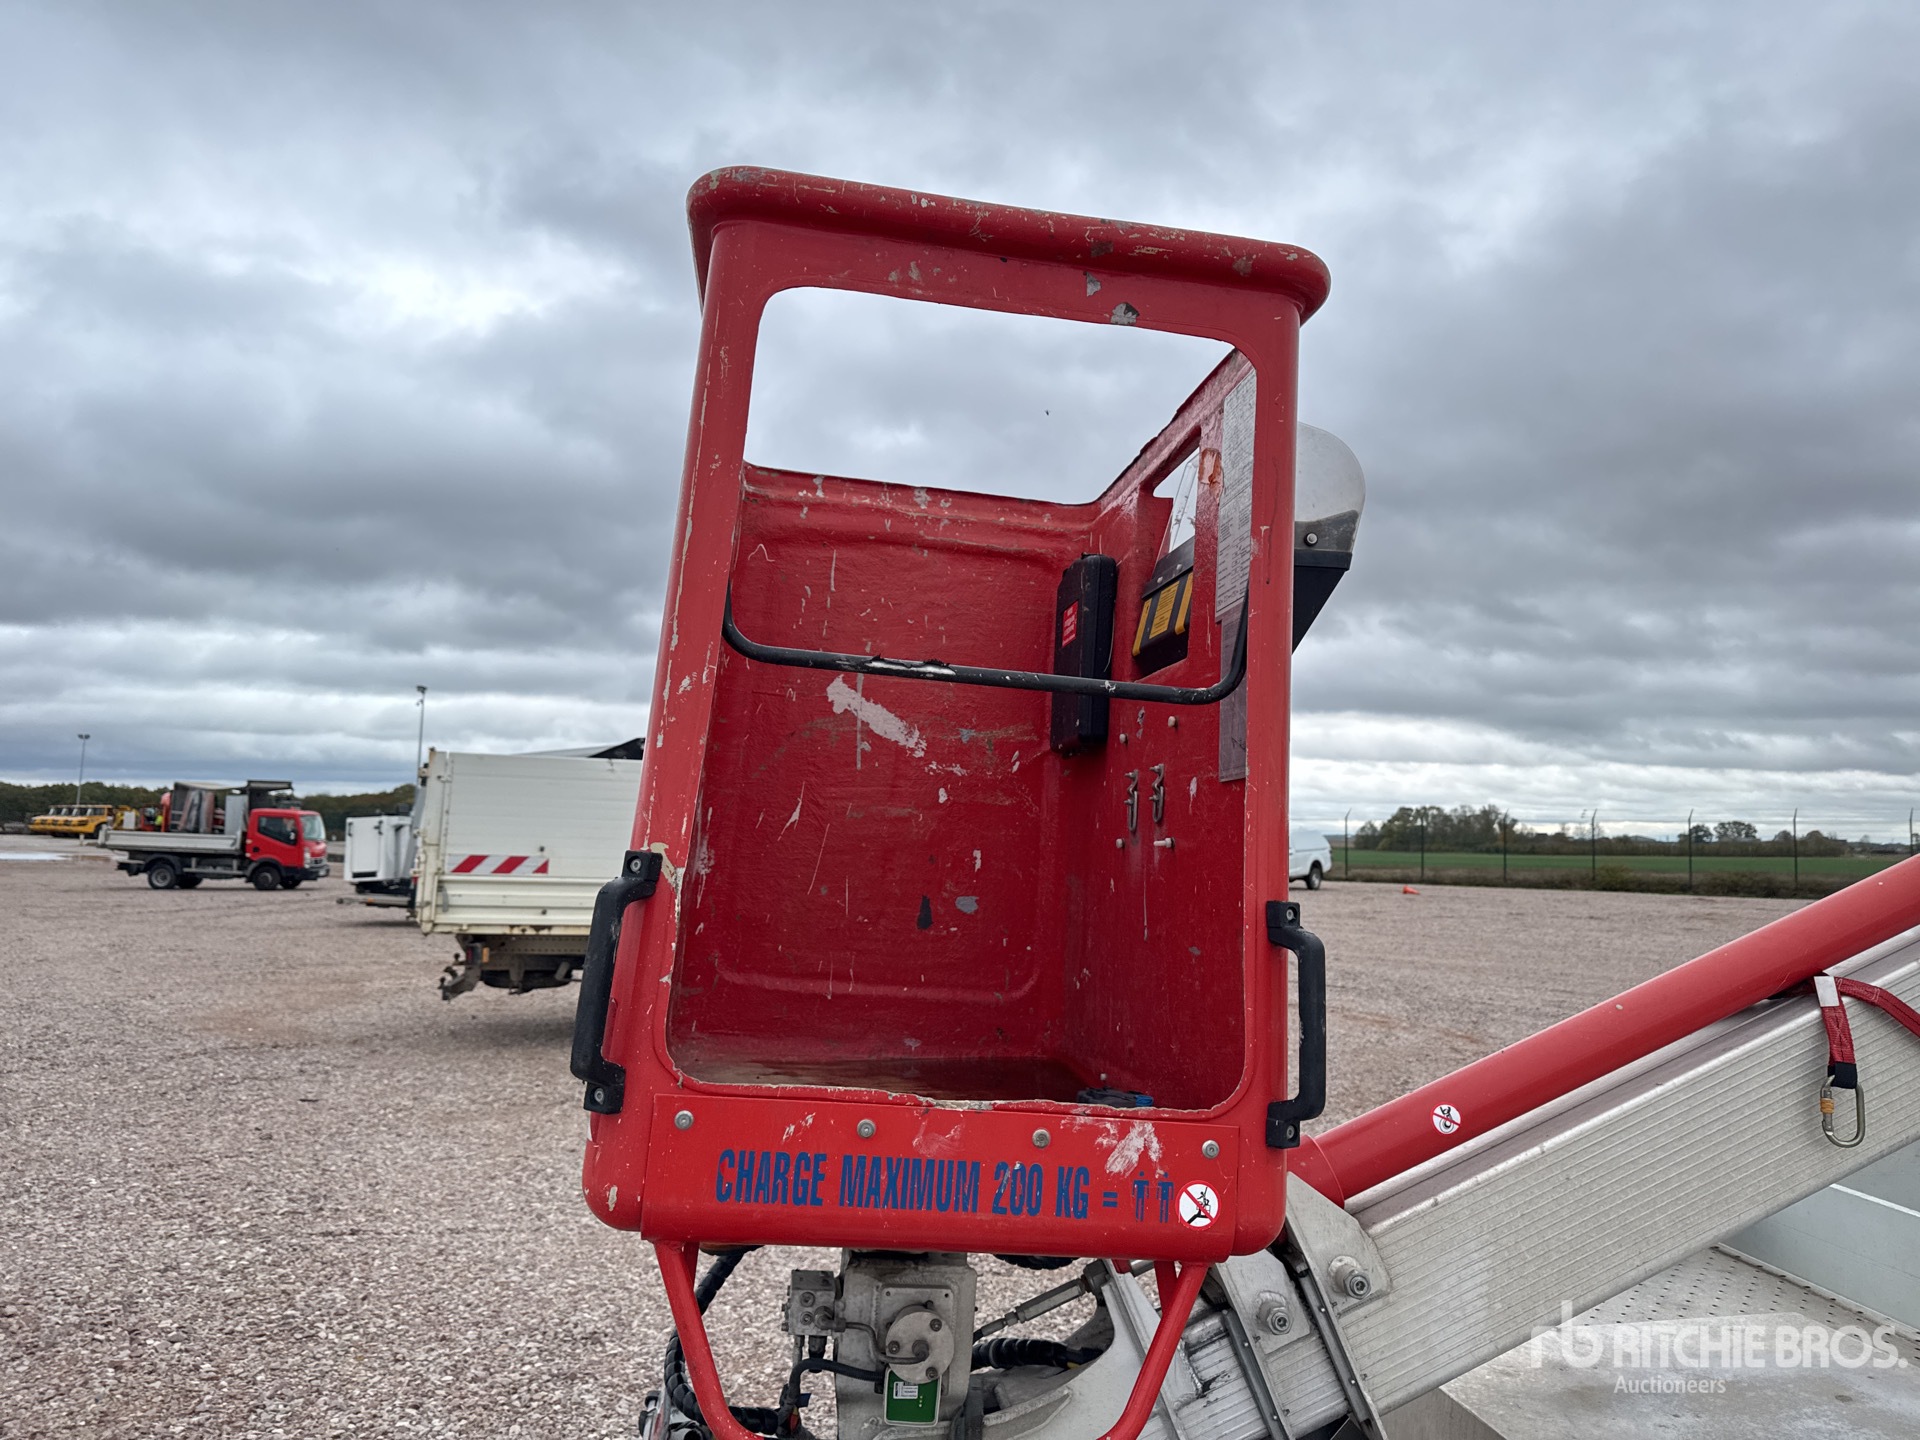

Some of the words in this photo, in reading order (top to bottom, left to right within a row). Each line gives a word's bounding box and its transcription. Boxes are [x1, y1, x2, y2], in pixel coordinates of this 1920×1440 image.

[715, 1149, 827, 1207] CHARGE
[839, 1154, 981, 1213] MAXIMUM
[991, 1161, 1044, 1217] 200
[1055, 1166, 1090, 1219] KG
